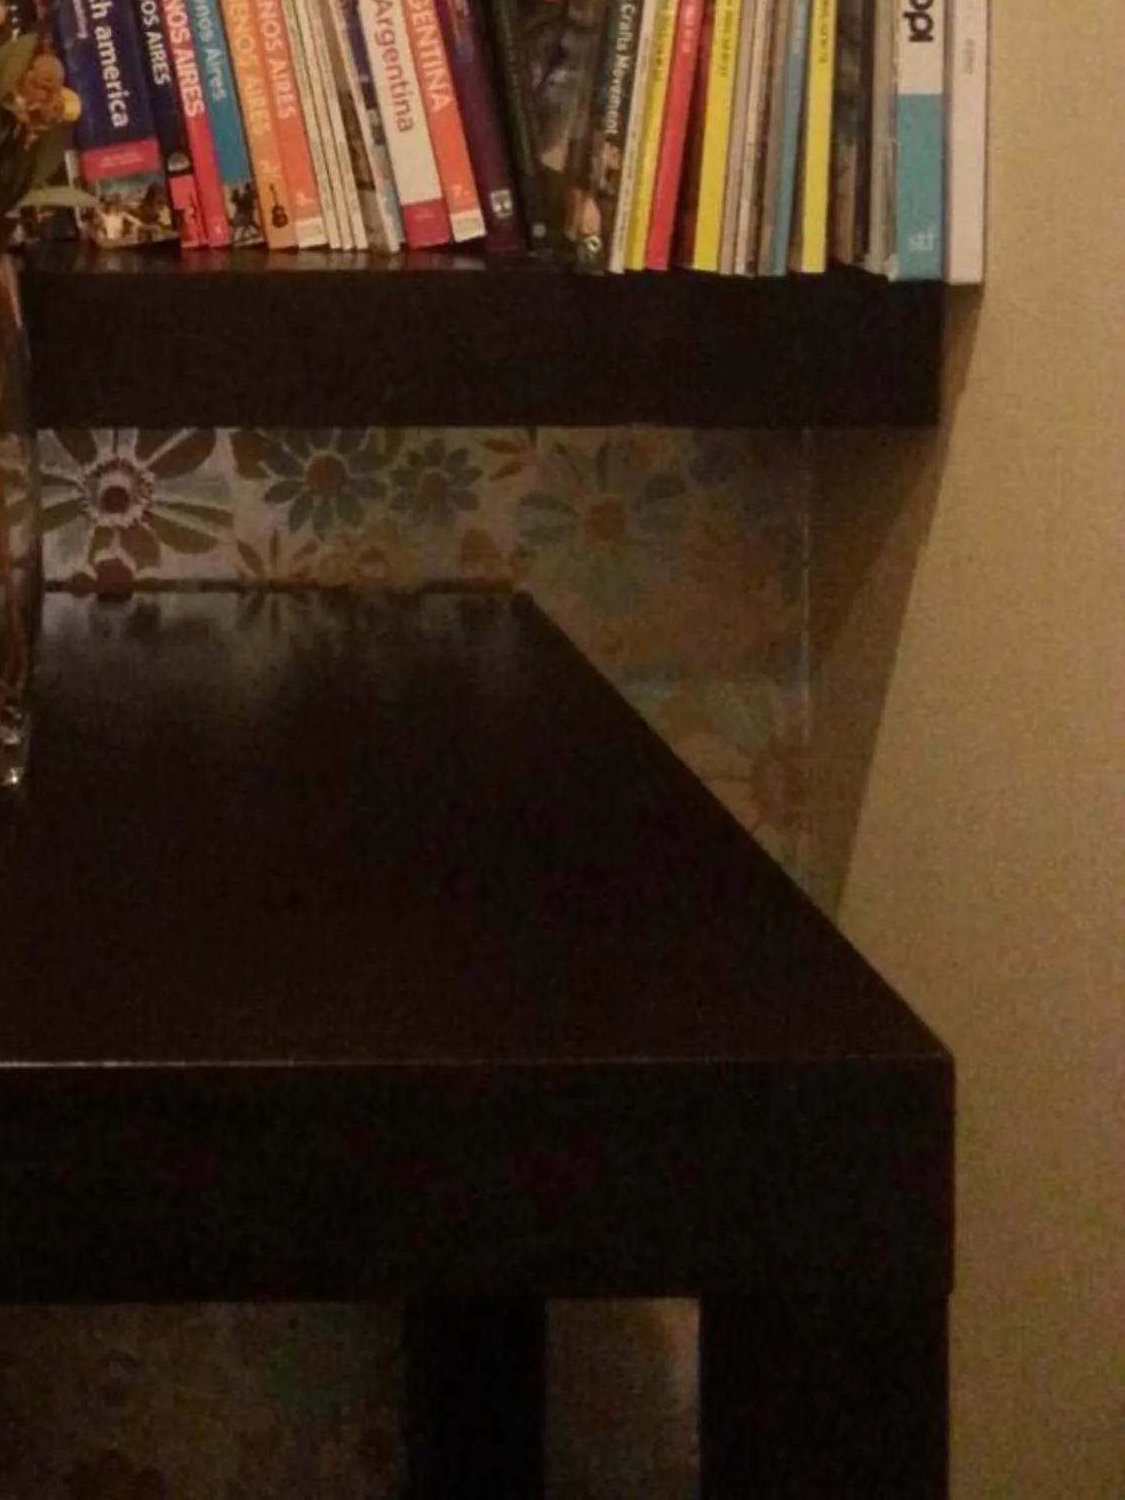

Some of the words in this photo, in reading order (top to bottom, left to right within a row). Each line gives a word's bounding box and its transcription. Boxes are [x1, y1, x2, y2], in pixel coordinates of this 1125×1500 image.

[146, 31, 171, 86] AIRES
[615, 4, 637, 51] Crafts
[92, 26, 131, 128] america
[176, 48, 205, 118] AIRES
[202, 46, 228, 100] Aires
[268, 58, 297, 120] AIRES
[604, 54, 632, 136] Movement
[243, 74, 273, 136] AIRES
